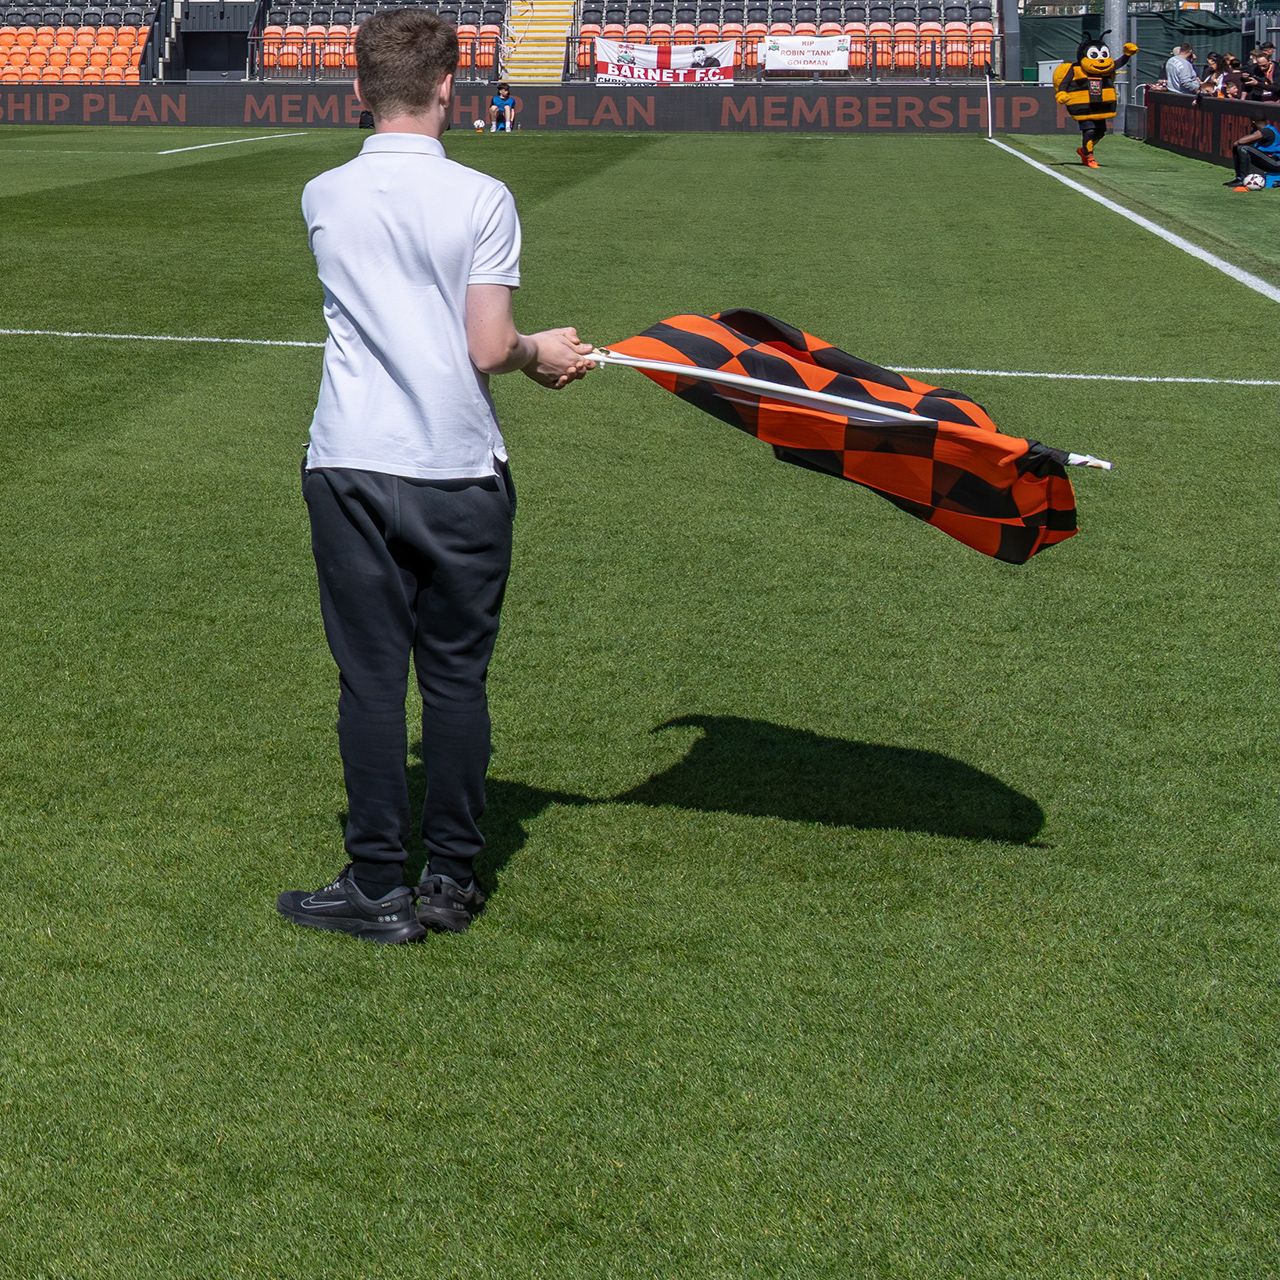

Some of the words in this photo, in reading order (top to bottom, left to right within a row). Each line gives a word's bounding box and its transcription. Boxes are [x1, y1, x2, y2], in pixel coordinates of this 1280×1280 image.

[608, 63, 688, 82] BARNET
[695, 68, 725, 81] F.C.
[83, 93, 187, 123] PLAN
[540, 95, 655, 126] PLAN
[720, 95, 1039, 129] MEMBERSHIP
